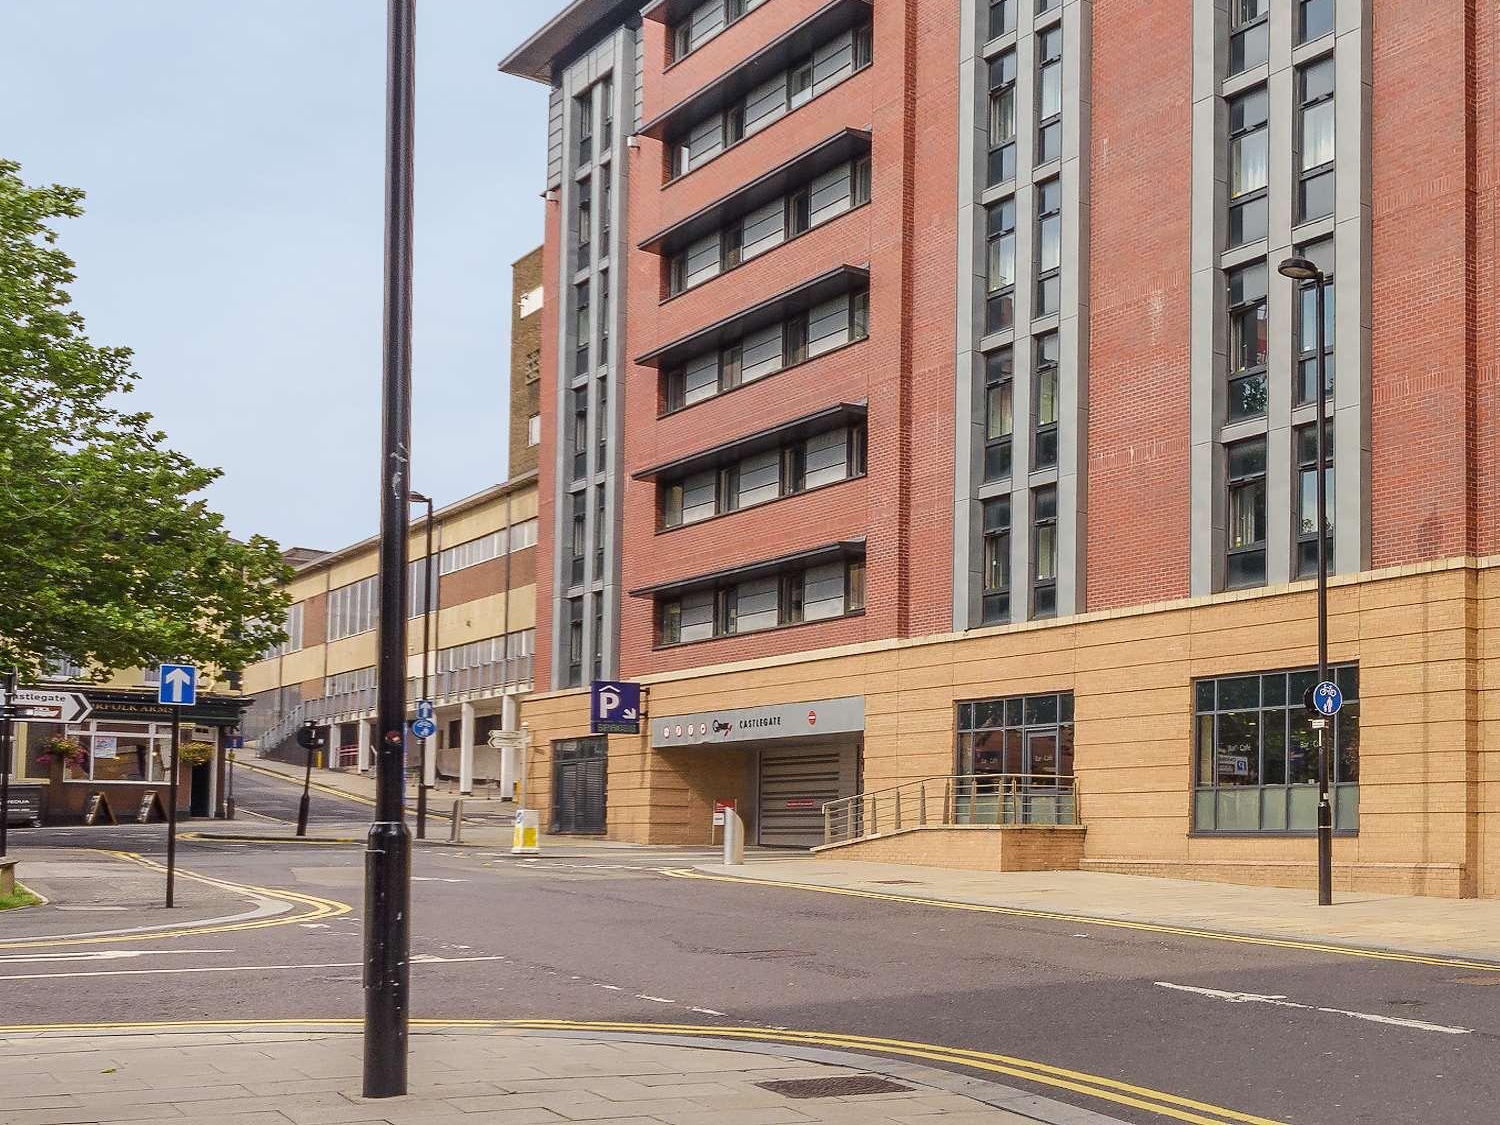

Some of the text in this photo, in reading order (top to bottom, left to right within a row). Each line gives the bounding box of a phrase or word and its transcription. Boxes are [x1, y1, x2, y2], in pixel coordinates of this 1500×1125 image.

[11, 692, 66, 703] astlegate
[600, 692, 620, 719] P
[739, 716, 782, 729] CASTLEGATE
